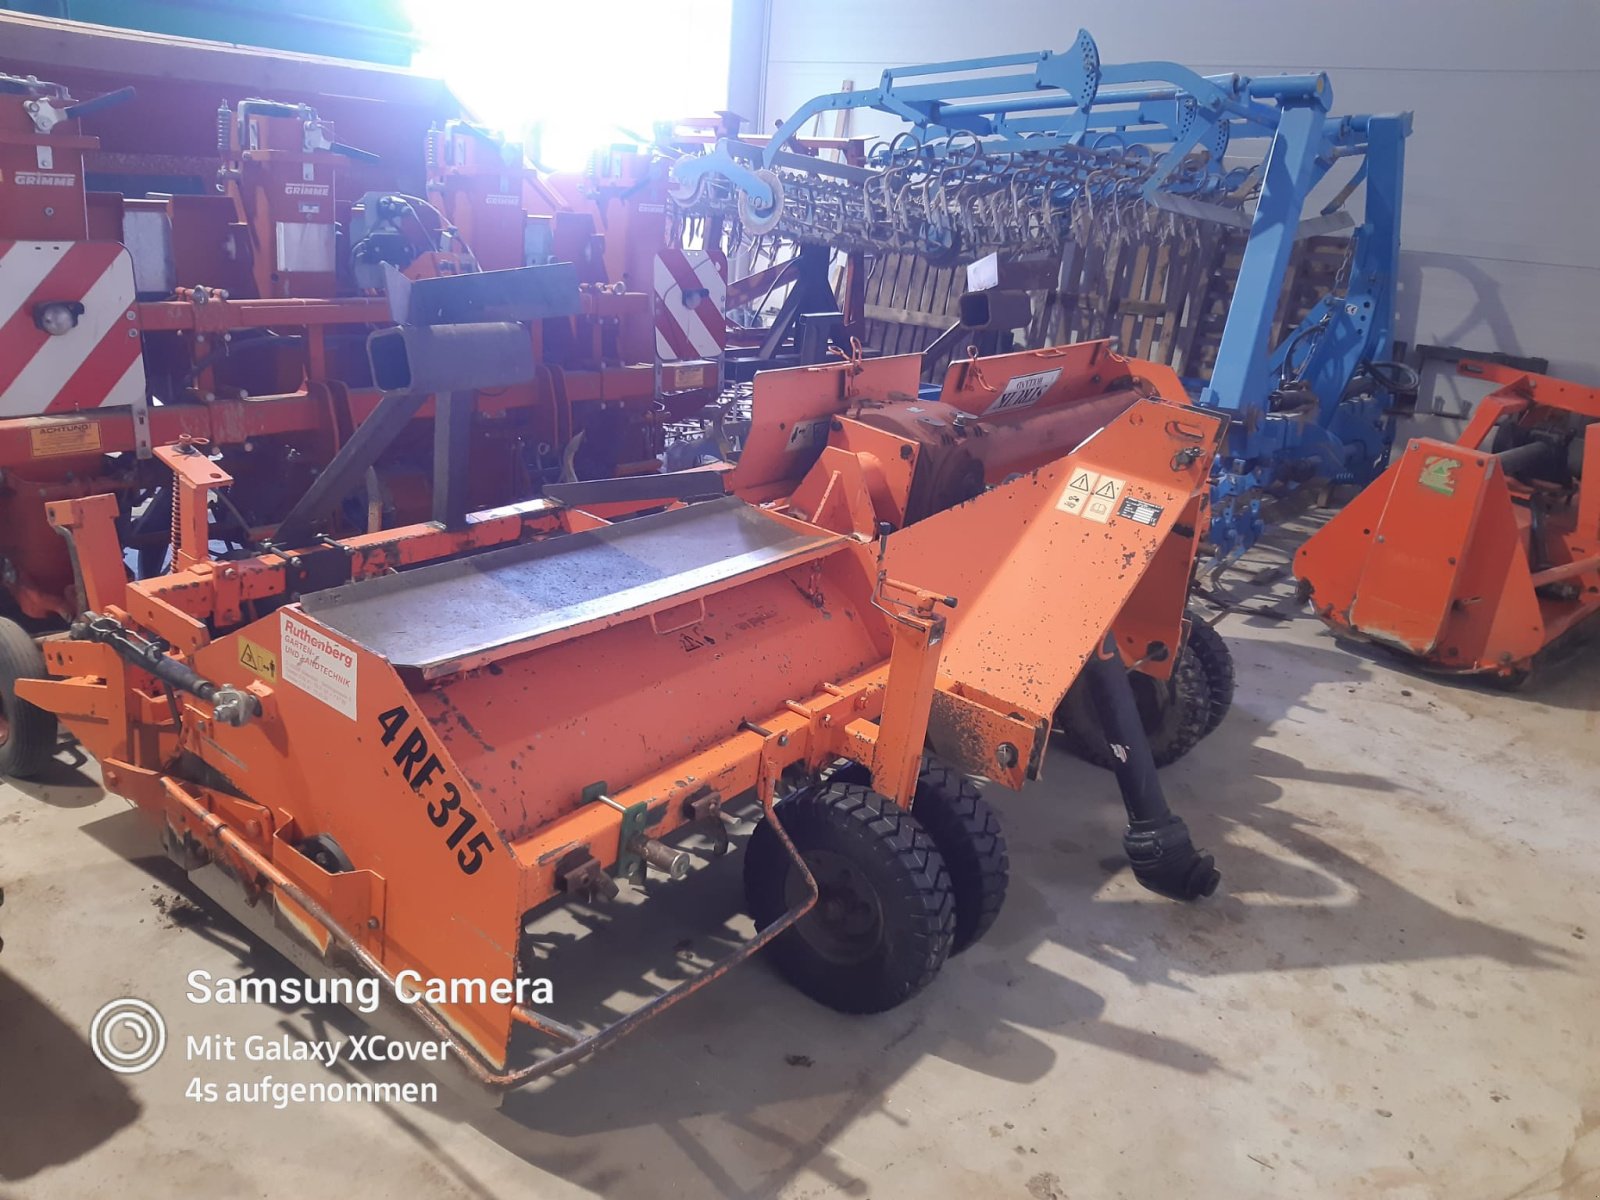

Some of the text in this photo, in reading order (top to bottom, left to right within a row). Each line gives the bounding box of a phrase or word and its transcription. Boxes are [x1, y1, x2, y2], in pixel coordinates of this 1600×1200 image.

[15, 172, 76, 187] GRIMME
[285, 183, 329, 196] GRIMME
[284, 620, 353, 668] Ruthenberg
[284, 645, 300, 659] UND
